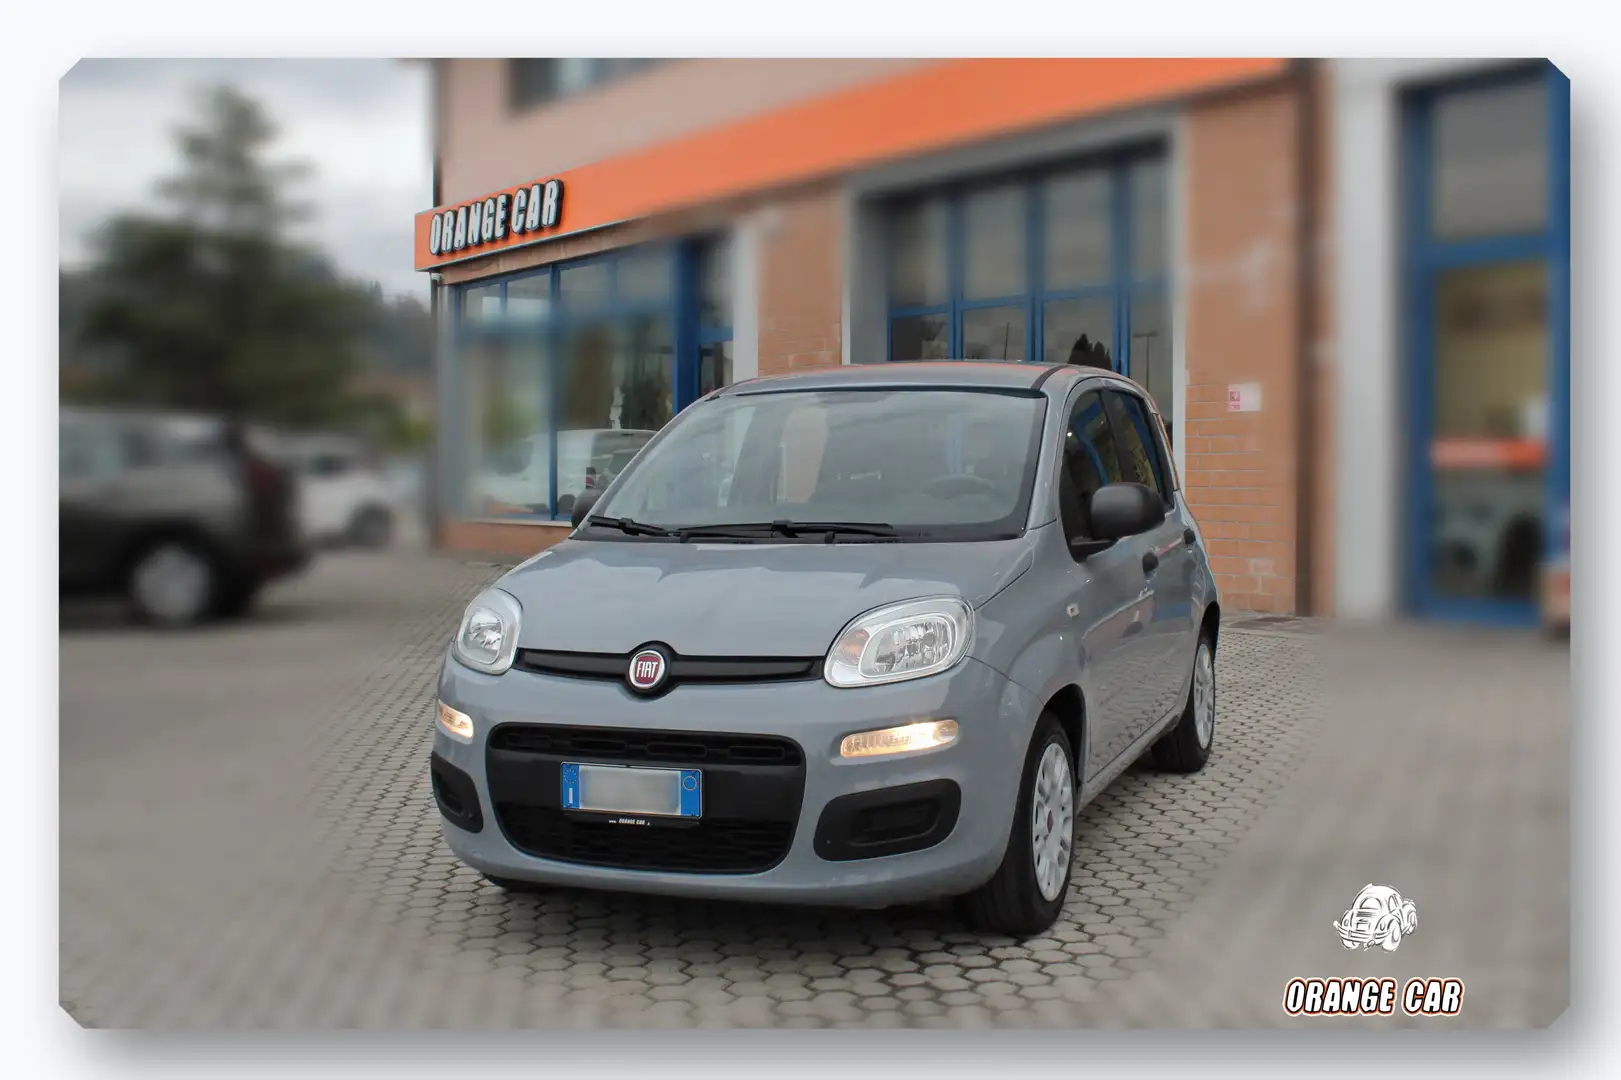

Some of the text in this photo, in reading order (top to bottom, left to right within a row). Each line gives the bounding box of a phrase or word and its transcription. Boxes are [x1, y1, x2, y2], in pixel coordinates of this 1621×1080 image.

[429, 179, 564, 255] ORANGE CAR
[636, 660, 659, 678] FIAT
